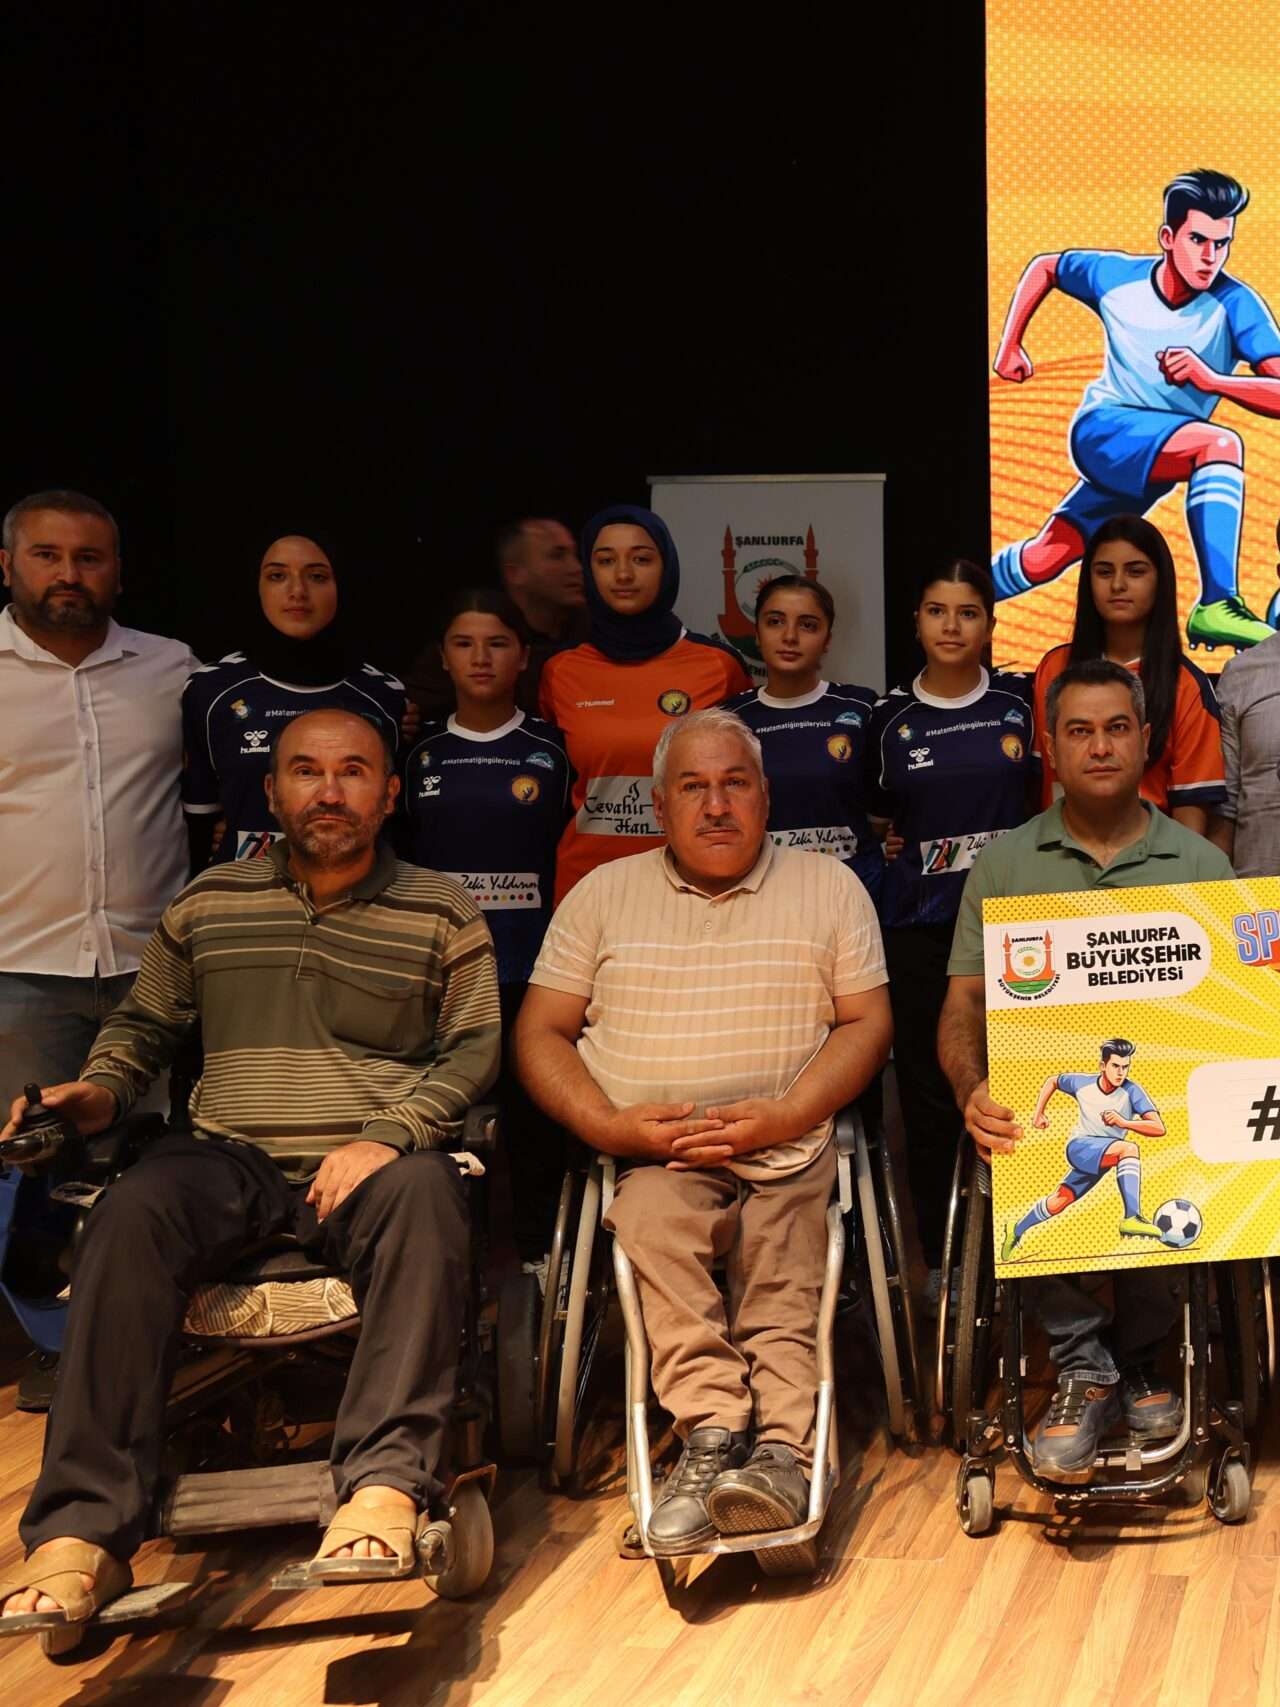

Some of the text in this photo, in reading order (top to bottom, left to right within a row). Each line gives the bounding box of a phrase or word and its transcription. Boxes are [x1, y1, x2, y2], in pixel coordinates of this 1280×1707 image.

[735, 535, 804, 548] ŞANLIURFA
[240, 745, 270, 754] hummel
[907, 759, 934, 771] hummel
[418, 788, 441, 798] hummel
[1086, 926, 1180, 948] ŞANLIURFA
